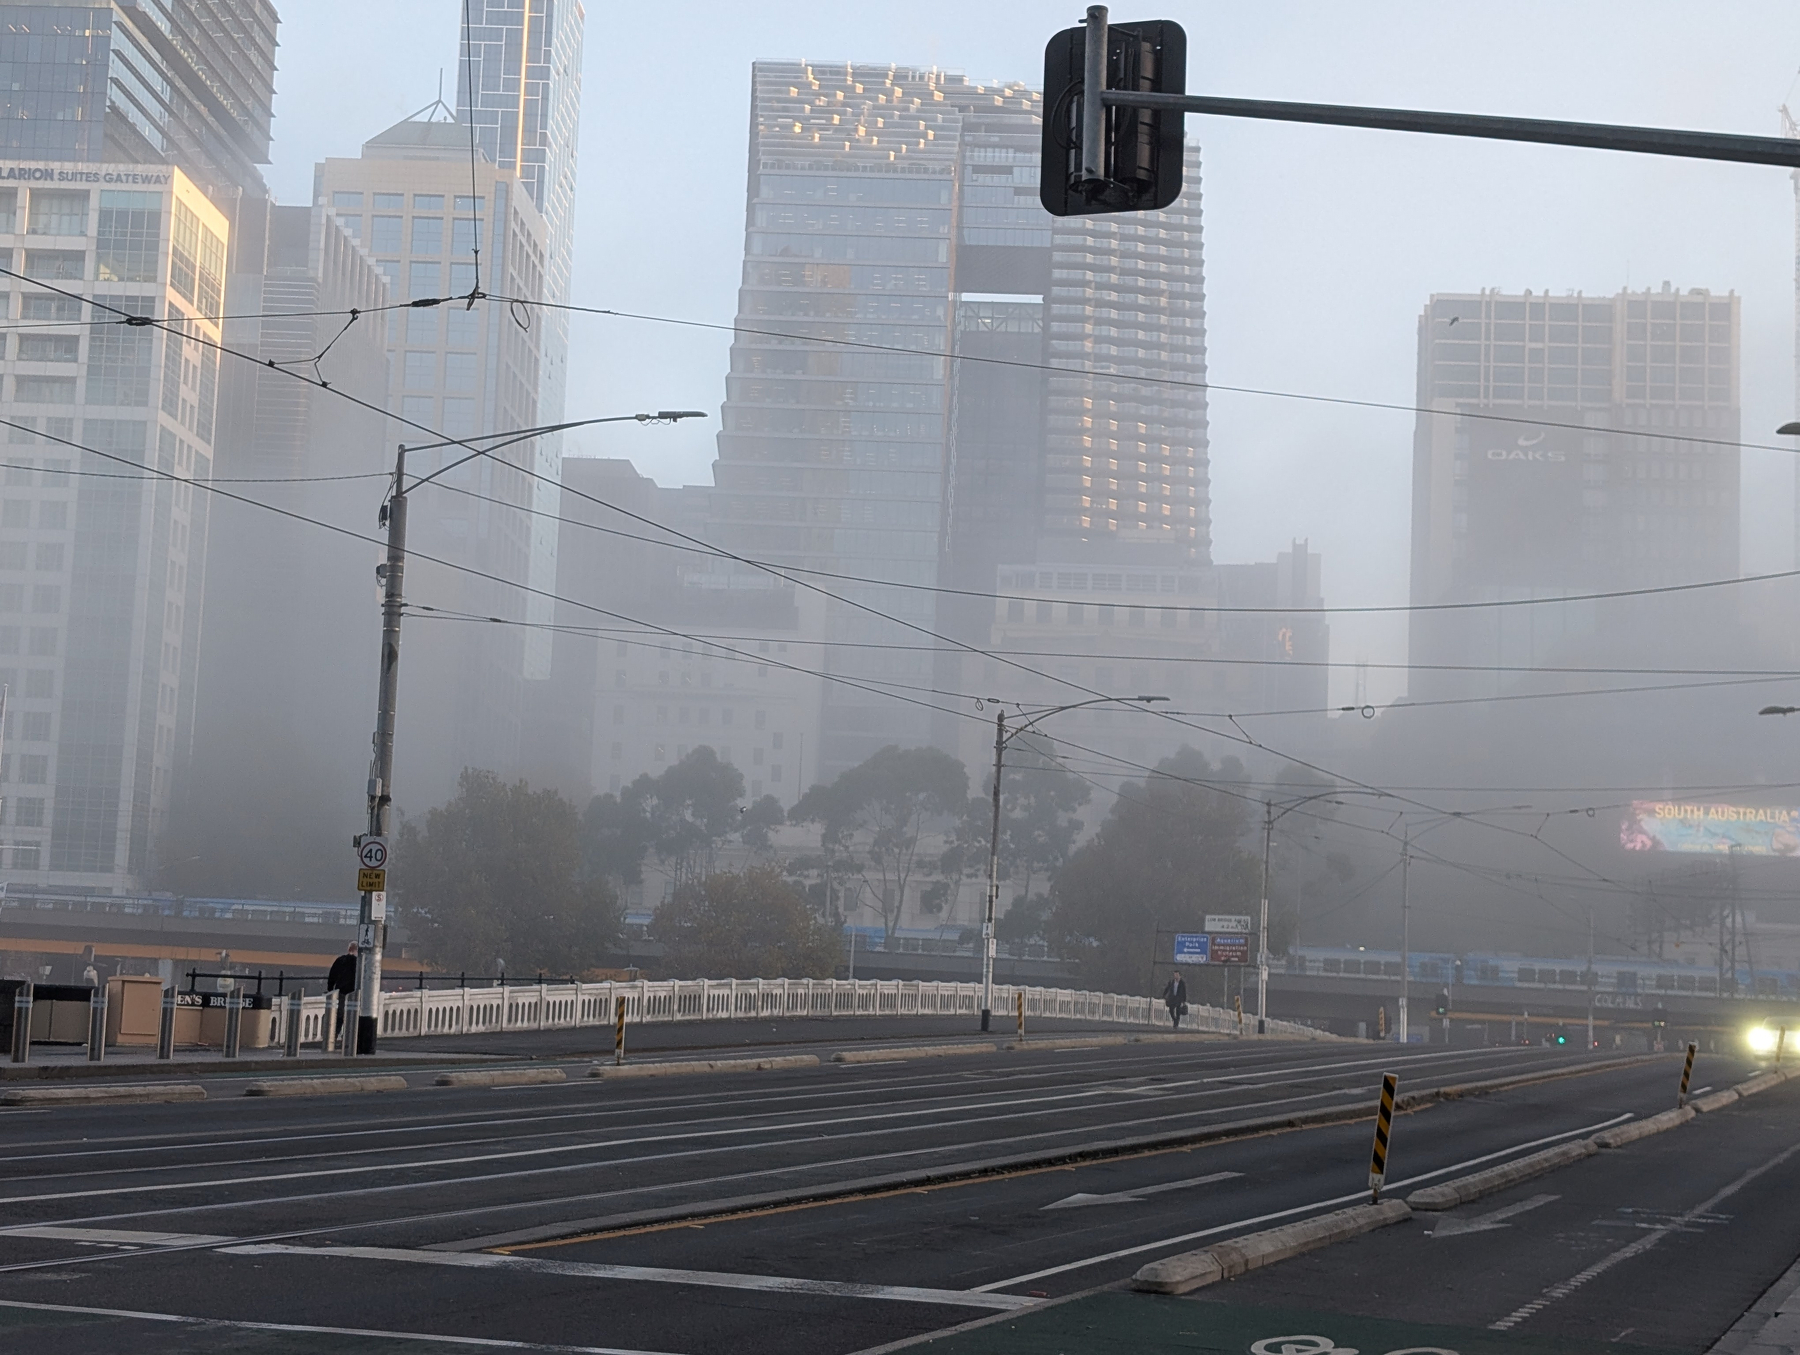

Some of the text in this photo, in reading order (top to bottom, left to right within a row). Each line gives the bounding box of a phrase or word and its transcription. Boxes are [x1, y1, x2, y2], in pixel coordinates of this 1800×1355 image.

[58, 170, 100, 183] SUITES
[103, 172, 171, 185] GATEWAY
[1487, 449, 1565, 461] OAKS
[1655, 805, 1790, 823] SOUTH AUSTRALIA
[363, 848, 384, 862] 40
[362, 872, 381, 880] NEW
[209, 996, 254, 1008] BRIGE
